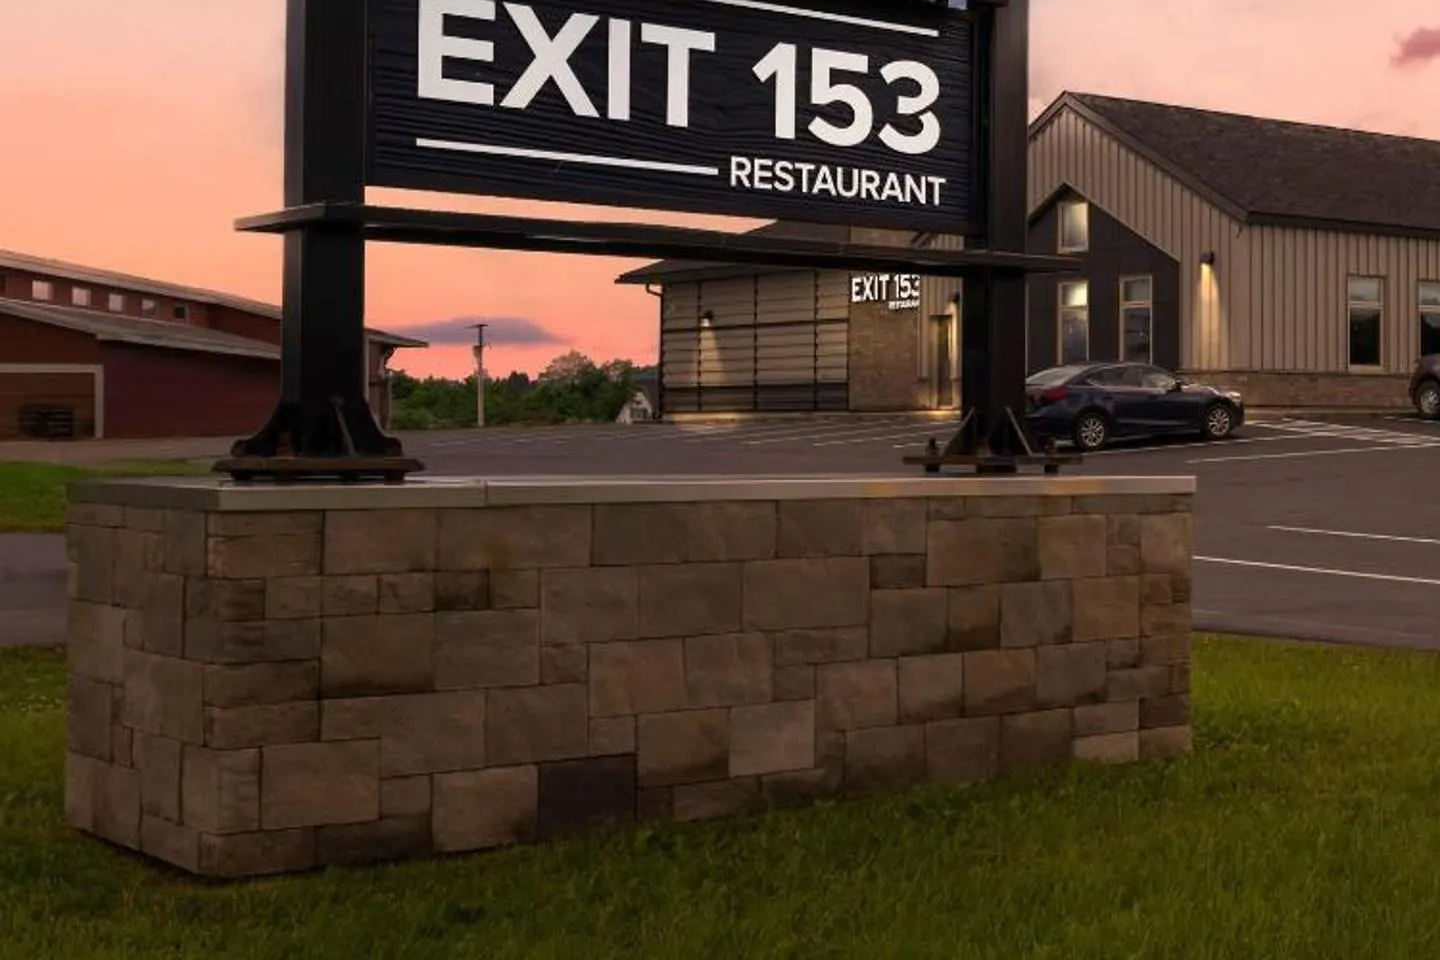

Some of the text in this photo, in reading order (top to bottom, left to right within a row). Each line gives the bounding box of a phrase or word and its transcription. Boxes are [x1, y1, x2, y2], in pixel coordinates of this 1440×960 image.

[751, 41, 941, 155] 153
[729, 155, 947, 207] RESTAURANT
[851, 273, 921, 302] EXIT 153
